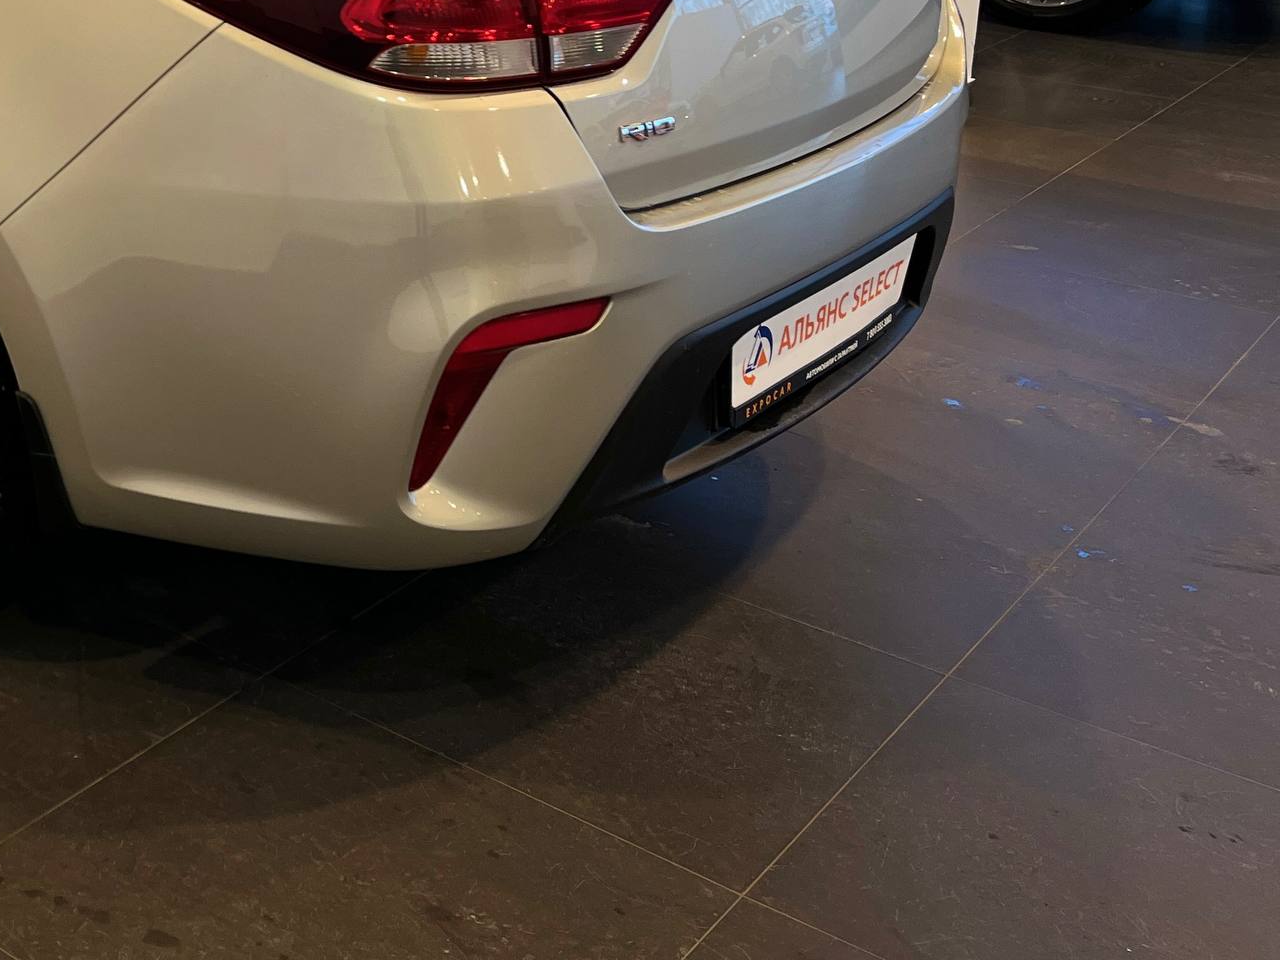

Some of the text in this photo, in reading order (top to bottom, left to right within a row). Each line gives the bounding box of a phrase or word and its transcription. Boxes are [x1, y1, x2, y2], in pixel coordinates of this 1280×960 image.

[618, 117, 675, 143] RIO
[778, 260, 904, 355] АЛЬЯНС SELECT
[745, 381, 792, 418] EXPOCAR
